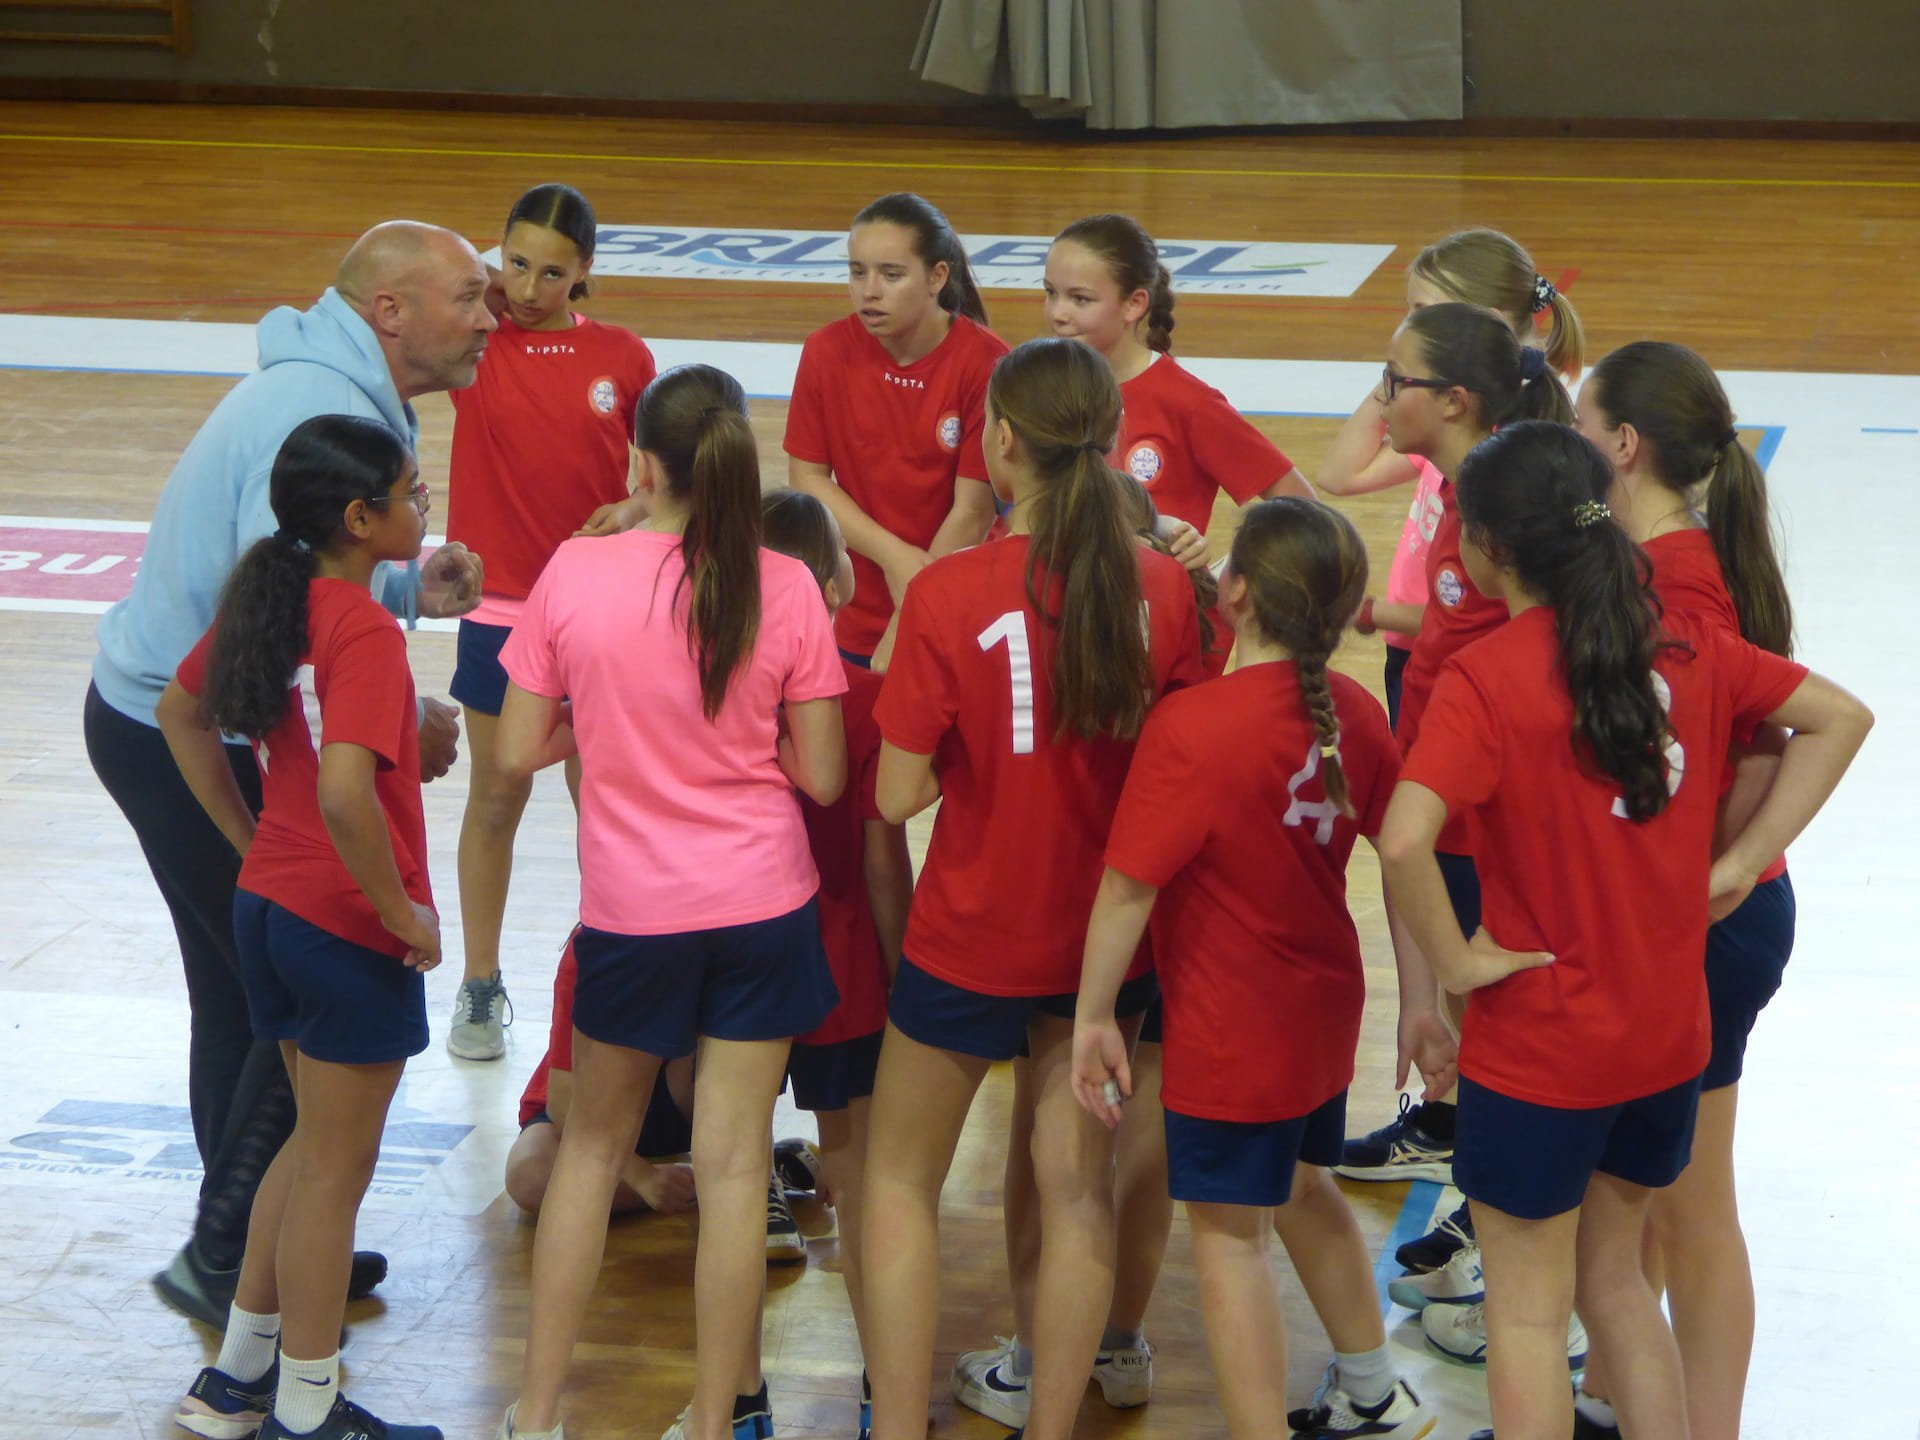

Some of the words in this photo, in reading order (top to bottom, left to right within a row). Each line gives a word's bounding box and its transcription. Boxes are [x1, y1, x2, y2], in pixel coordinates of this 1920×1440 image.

[595, 230, 850, 265] BRL
[968, 241, 1308, 276] BL
[526, 345, 575, 355] KIPSTA
[884, 372, 924, 389] KPSTA
[0, 550, 142, 575] BU
[1121, 1356, 1144, 1367] NIKE
